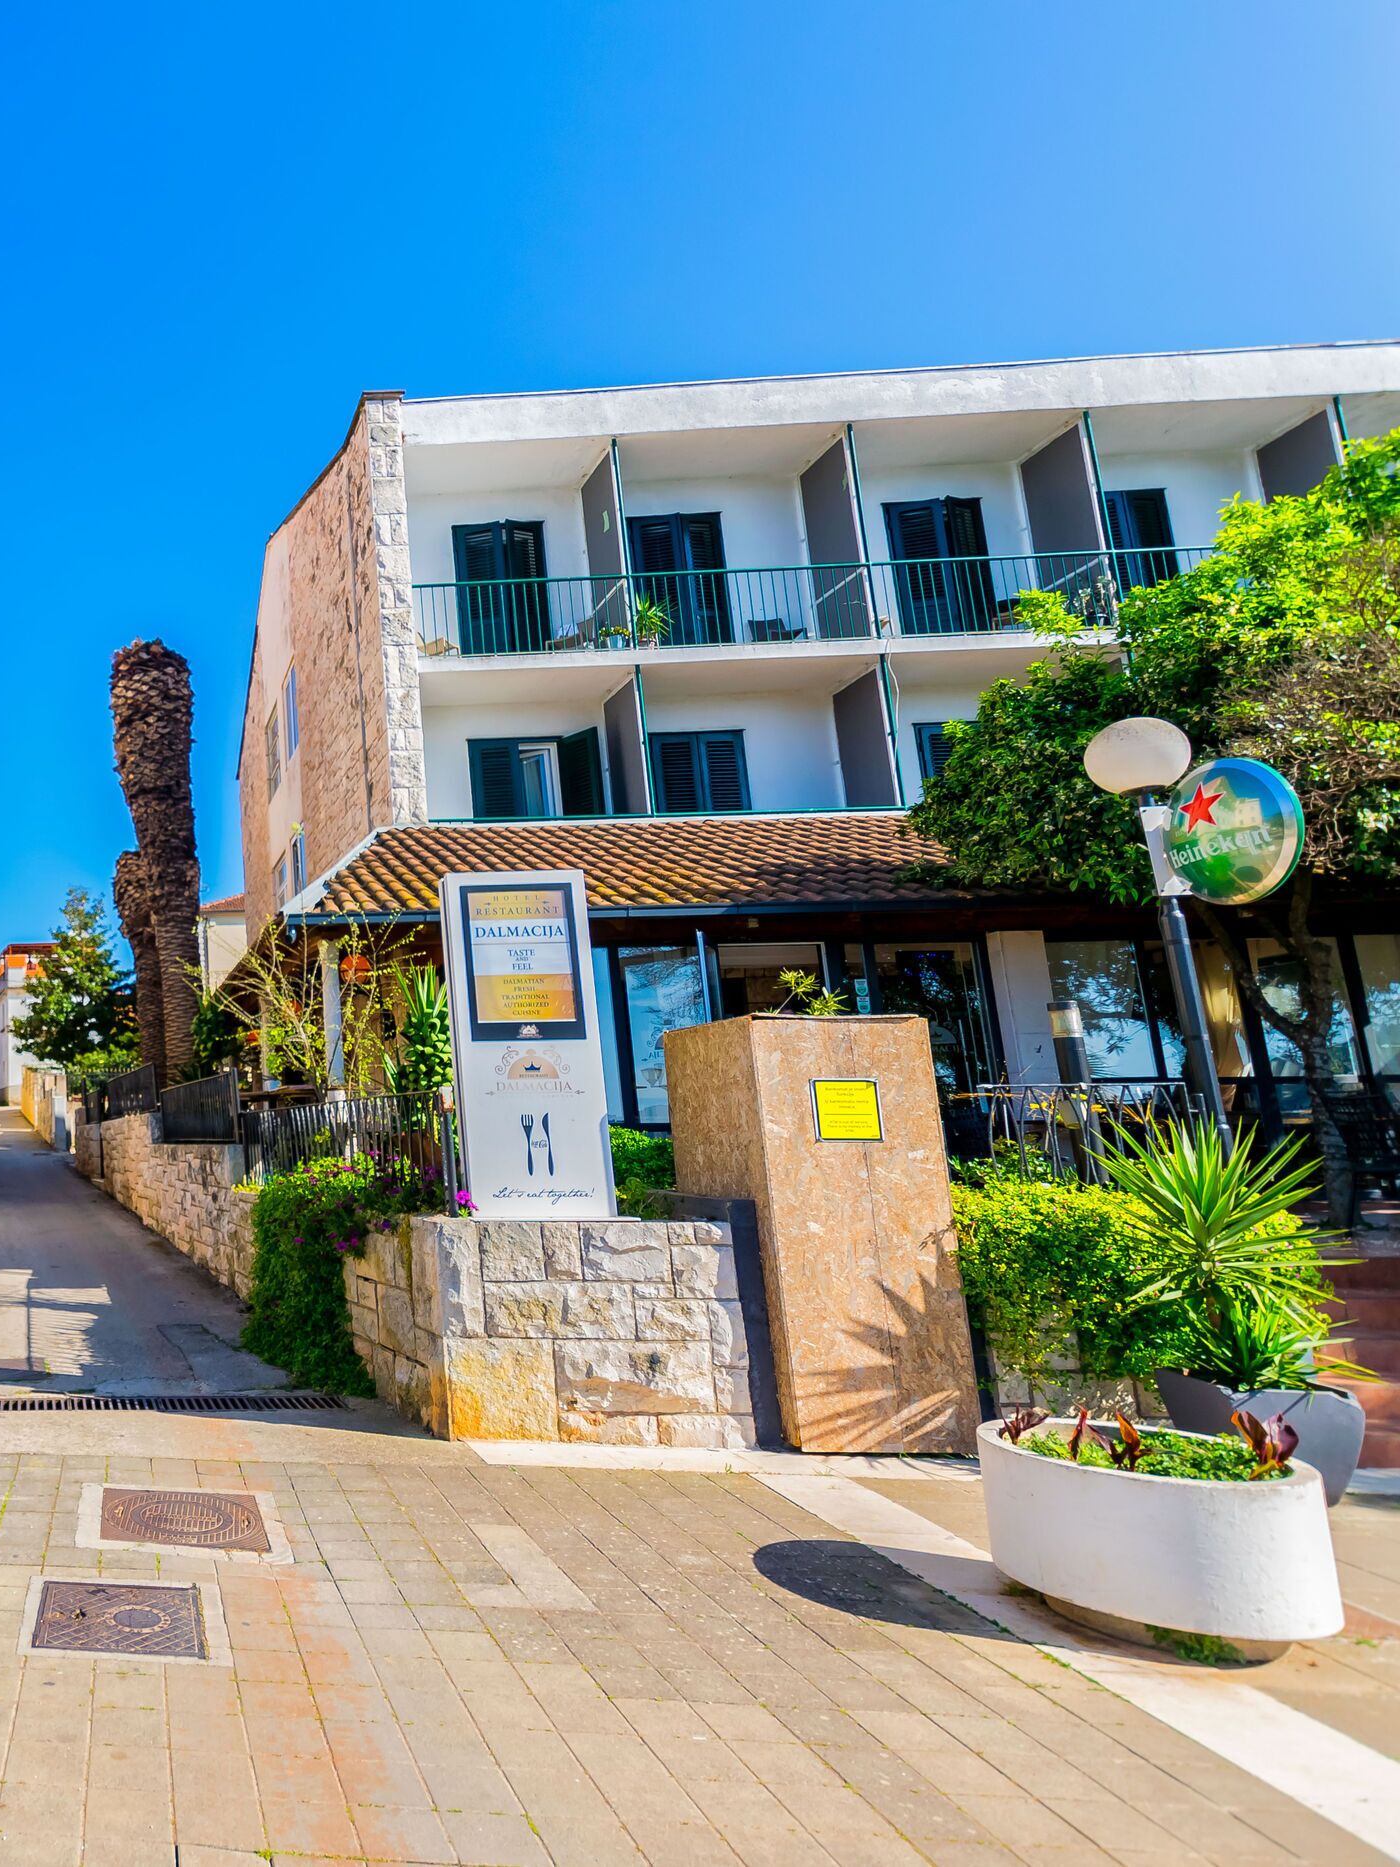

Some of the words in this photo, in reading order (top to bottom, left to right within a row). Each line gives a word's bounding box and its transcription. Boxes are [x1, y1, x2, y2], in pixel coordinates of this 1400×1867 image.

[1169, 825, 1273, 869] Heineken
[475, 906, 560, 916] RESTAURANT
[474, 925, 564, 938] DALMACIJA
[512, 963, 534, 971] FEEL
[496, 1081, 573, 1092] DALMACIJA
[492, 1187, 524, 1198] Let's
[527, 1188, 544, 1198] eat
[546, 1187, 595, 1206] together!
